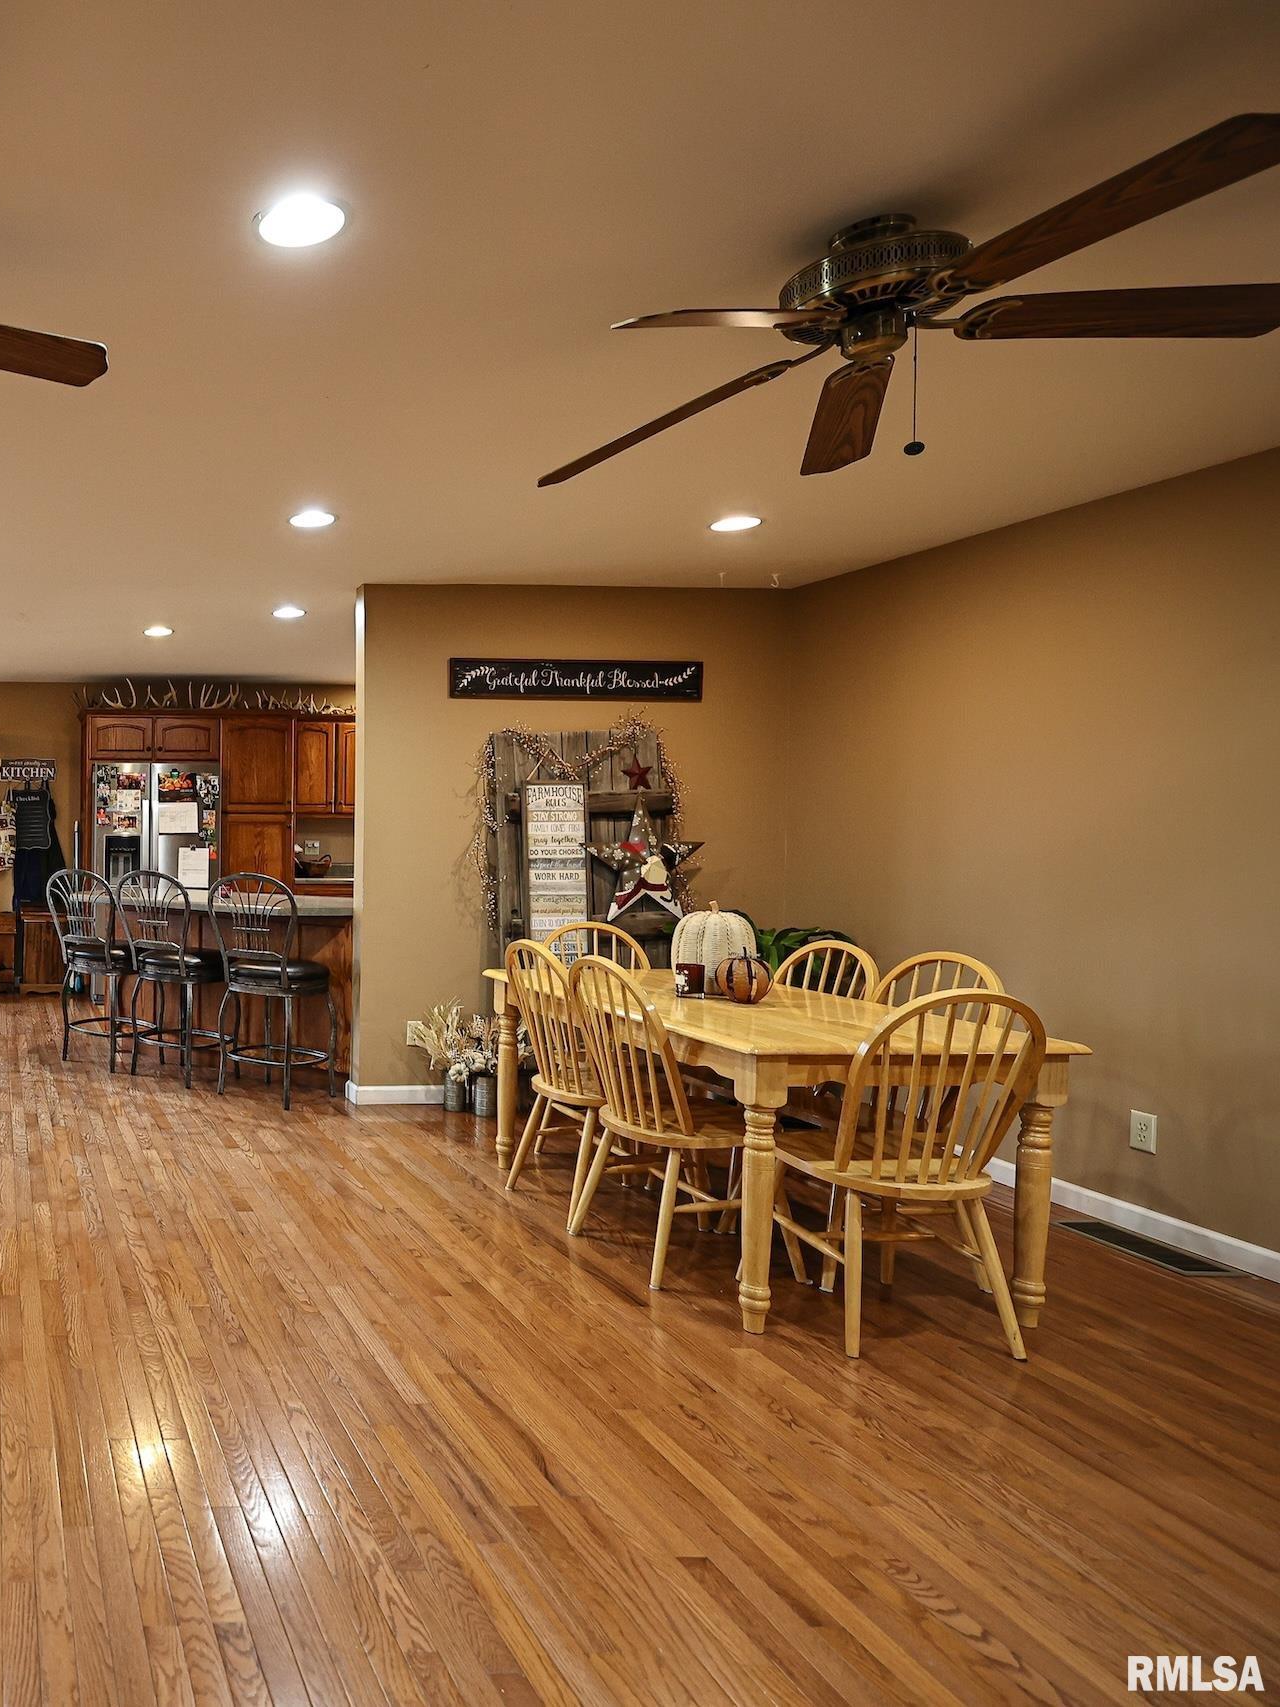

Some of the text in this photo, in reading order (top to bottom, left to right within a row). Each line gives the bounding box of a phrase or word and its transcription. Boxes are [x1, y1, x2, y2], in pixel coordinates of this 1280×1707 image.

[486, 667, 659, 694] Grateful Thankful Blessed
[2, 766, 55, 778] KITCHEN
[526, 786, 584, 806] FARMHOUSE
[532, 811, 578, 821] STAY STRONG
[558, 848, 584, 856] CHORES
[534, 872, 580, 881] WORK HARD
